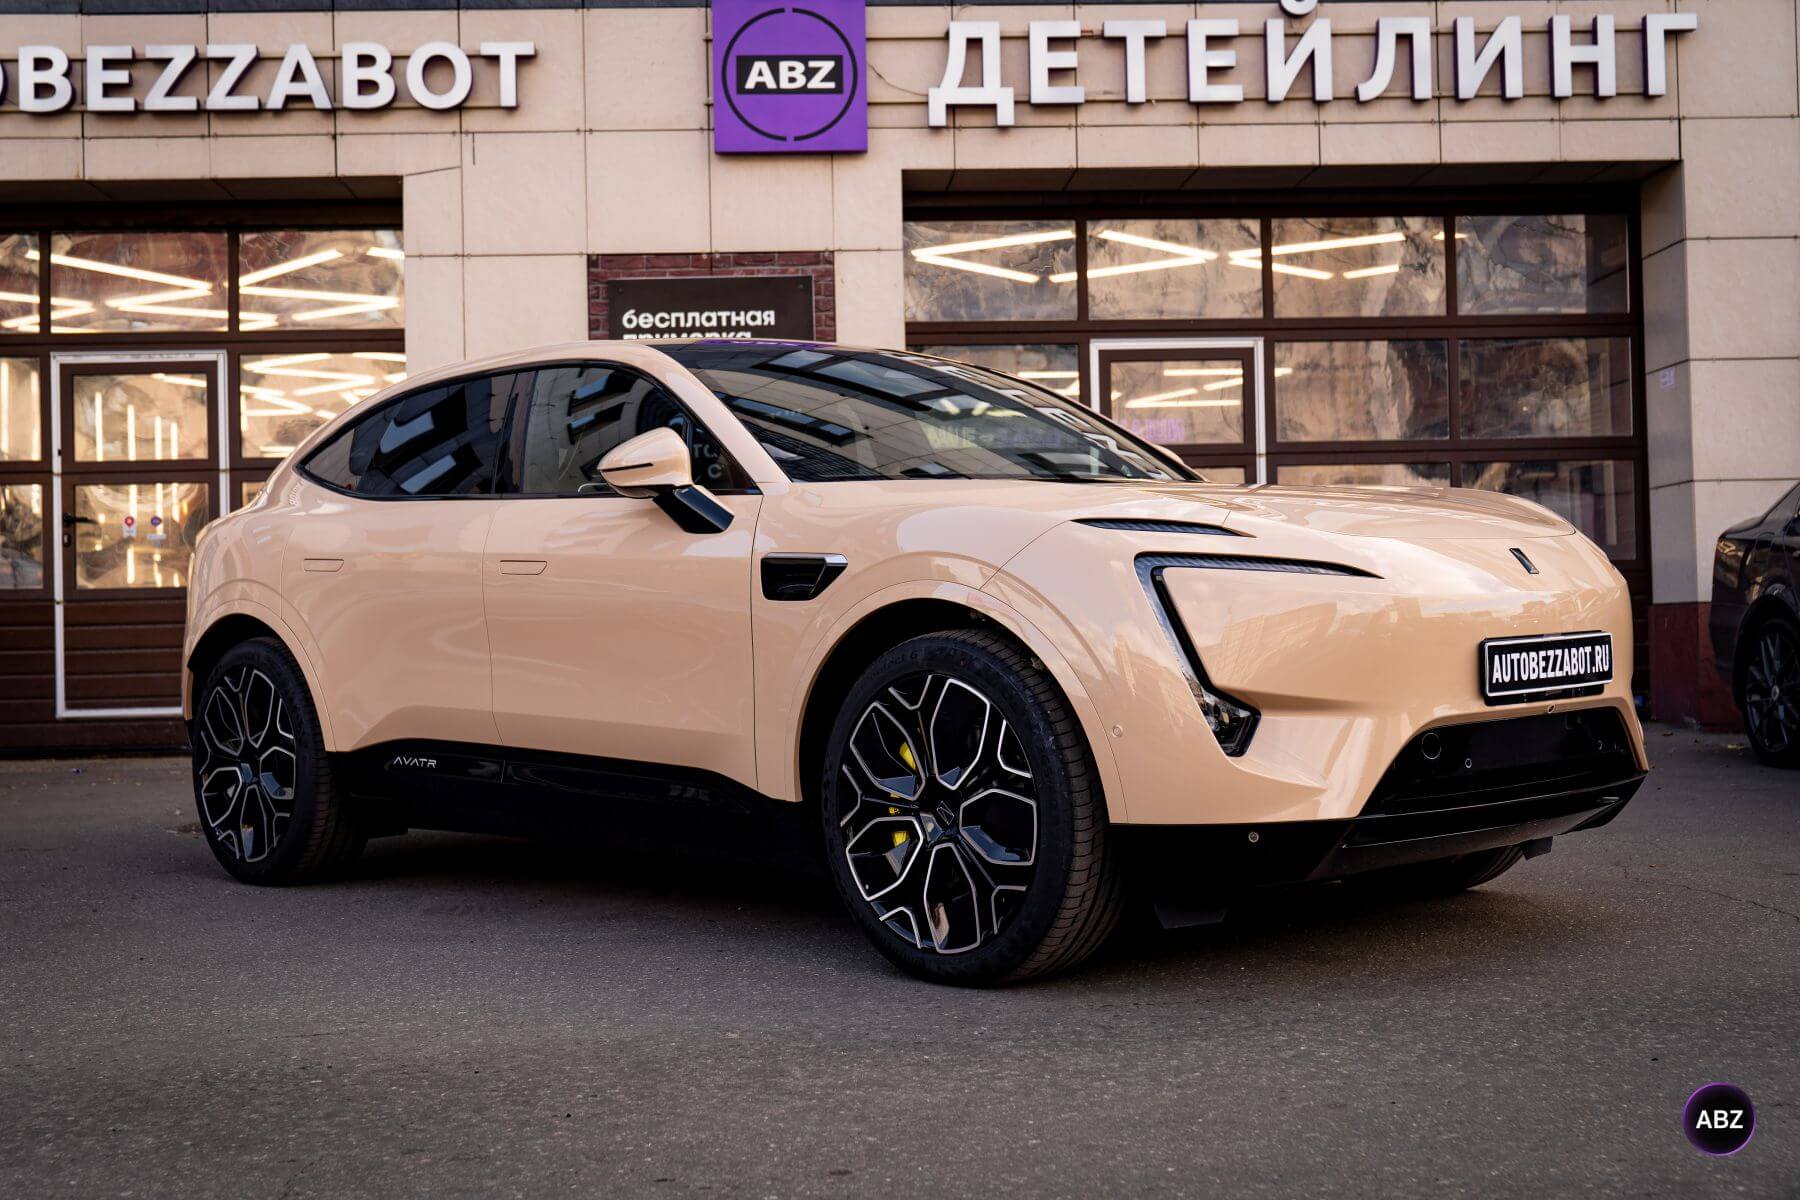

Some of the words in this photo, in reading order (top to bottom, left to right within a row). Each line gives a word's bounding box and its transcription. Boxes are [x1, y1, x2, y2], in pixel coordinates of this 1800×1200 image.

[0, 41, 535, 112] BEZZABOT
[745, 60, 836, 89] ABZ
[928, 0, 1697, 127] ДЕТЕЙЛИНГ
[622, 309, 775, 329] бесплатная
[1492, 644, 1609, 684] AUTOBEZZABOT.RU
[393, 756, 436, 768] AVATR
